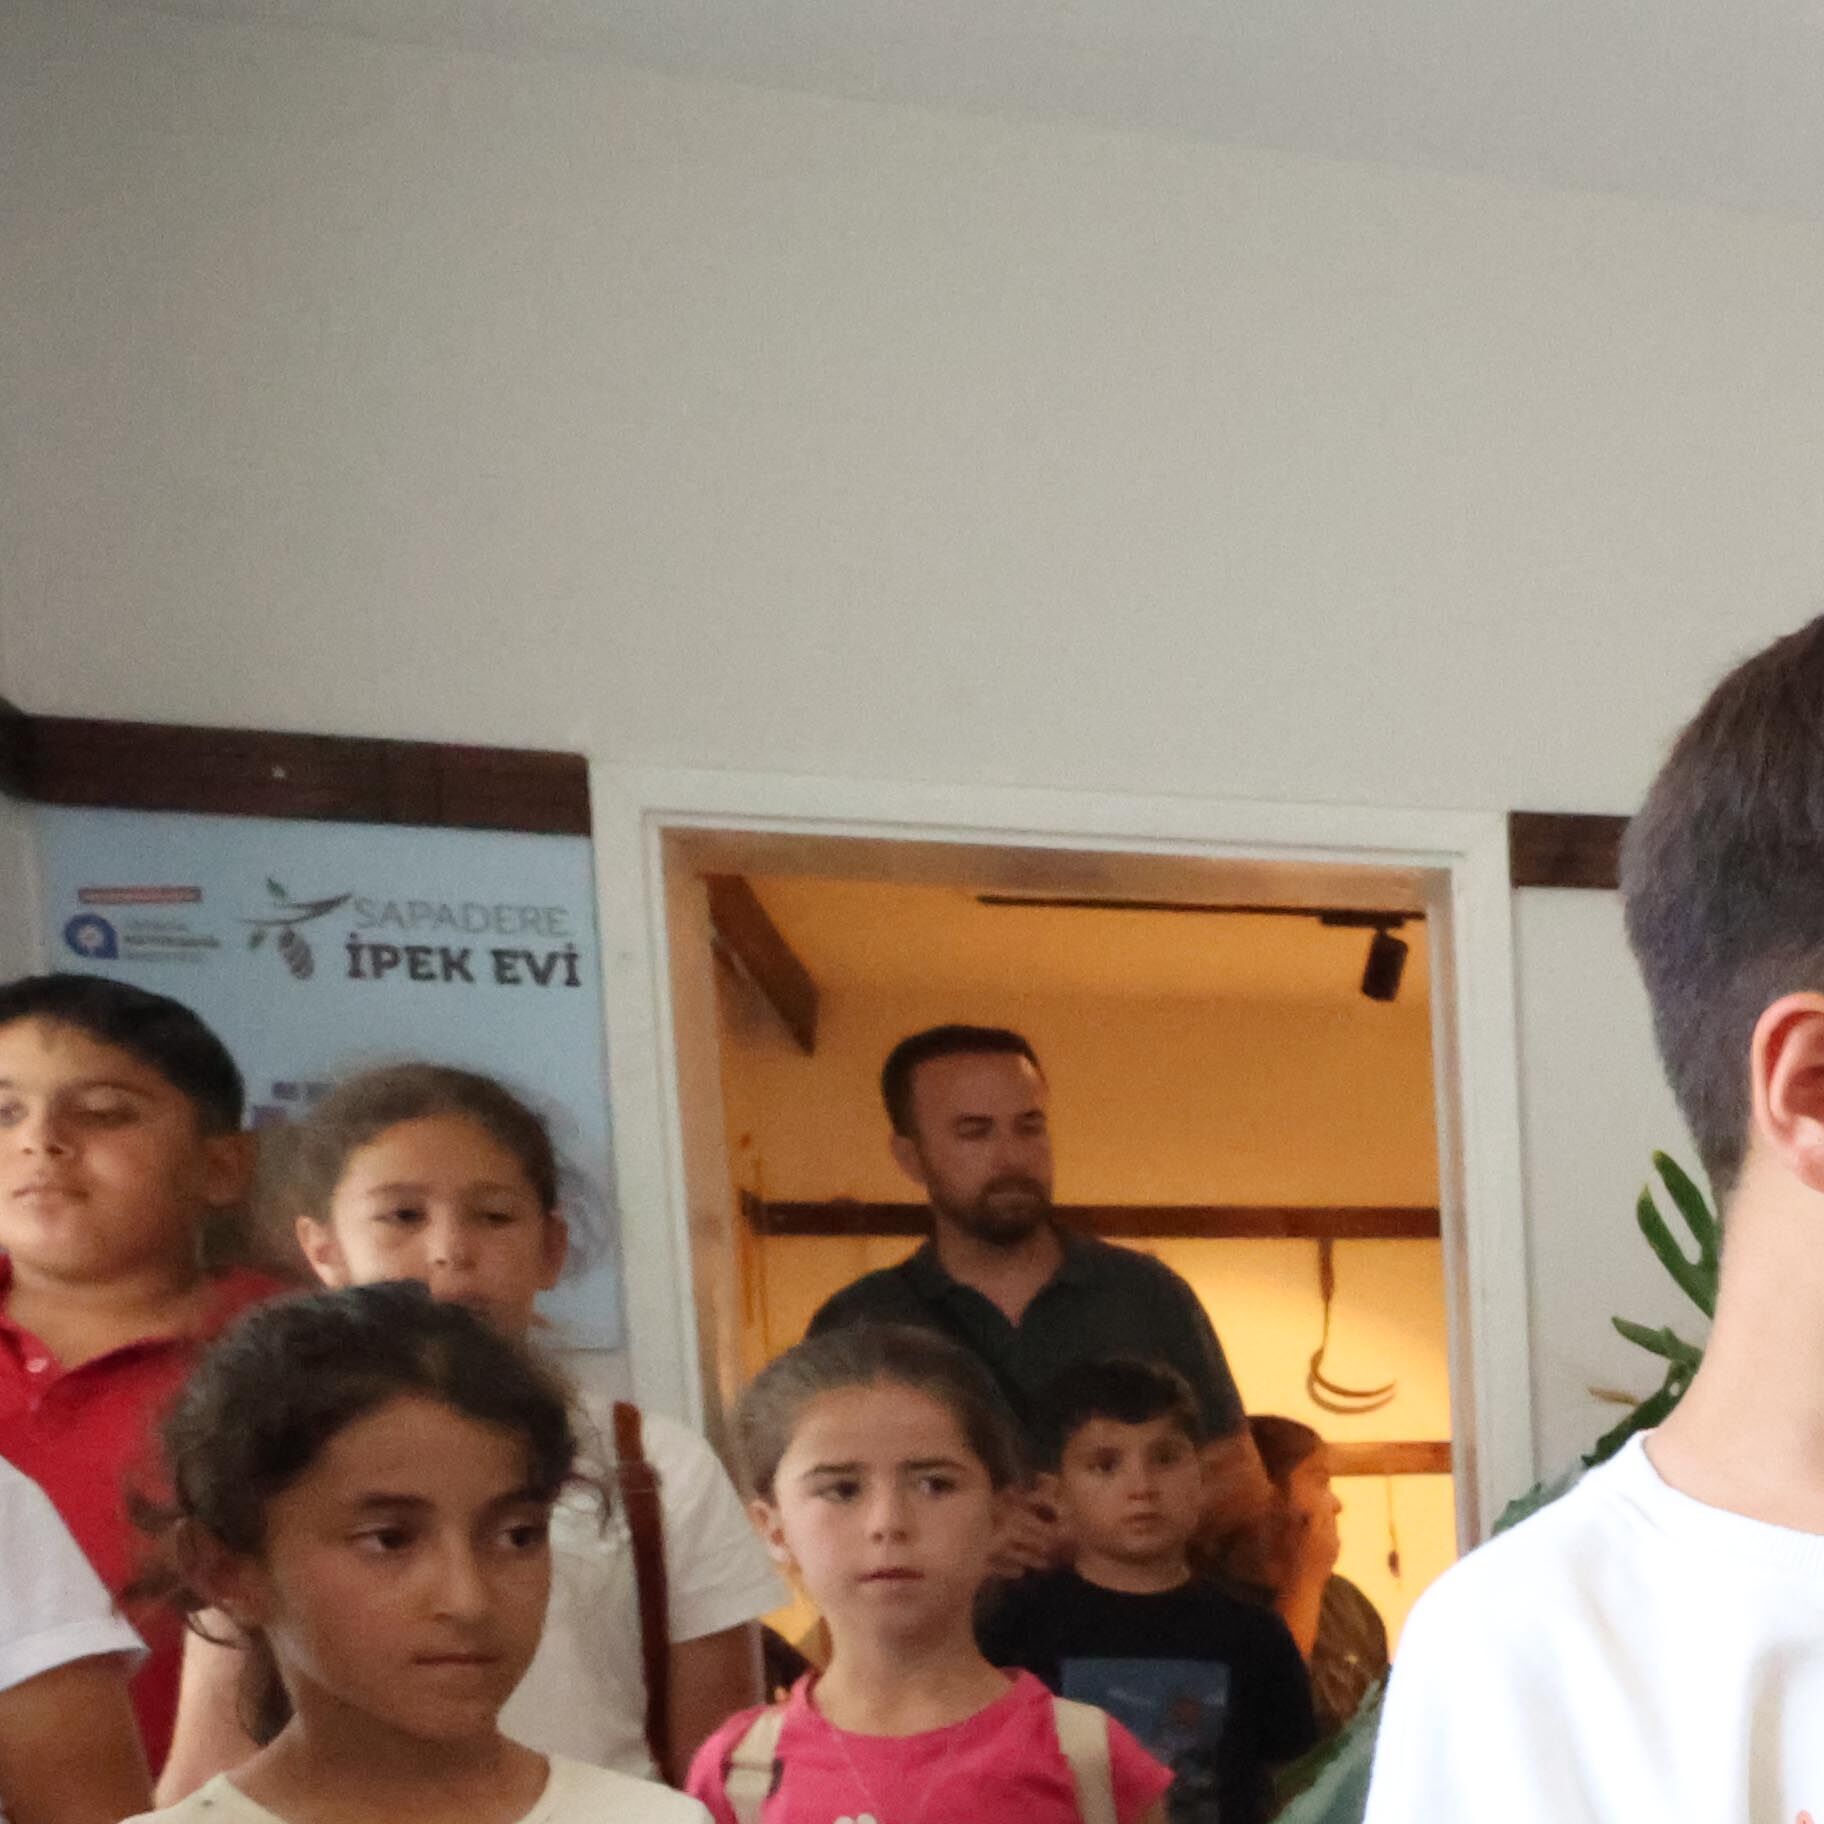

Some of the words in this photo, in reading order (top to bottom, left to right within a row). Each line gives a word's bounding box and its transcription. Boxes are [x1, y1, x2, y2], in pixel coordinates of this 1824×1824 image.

[354, 898, 569, 938] SAPADERE
[345, 933, 477, 985] İPEK
[491, 942, 583, 988] EVİ
